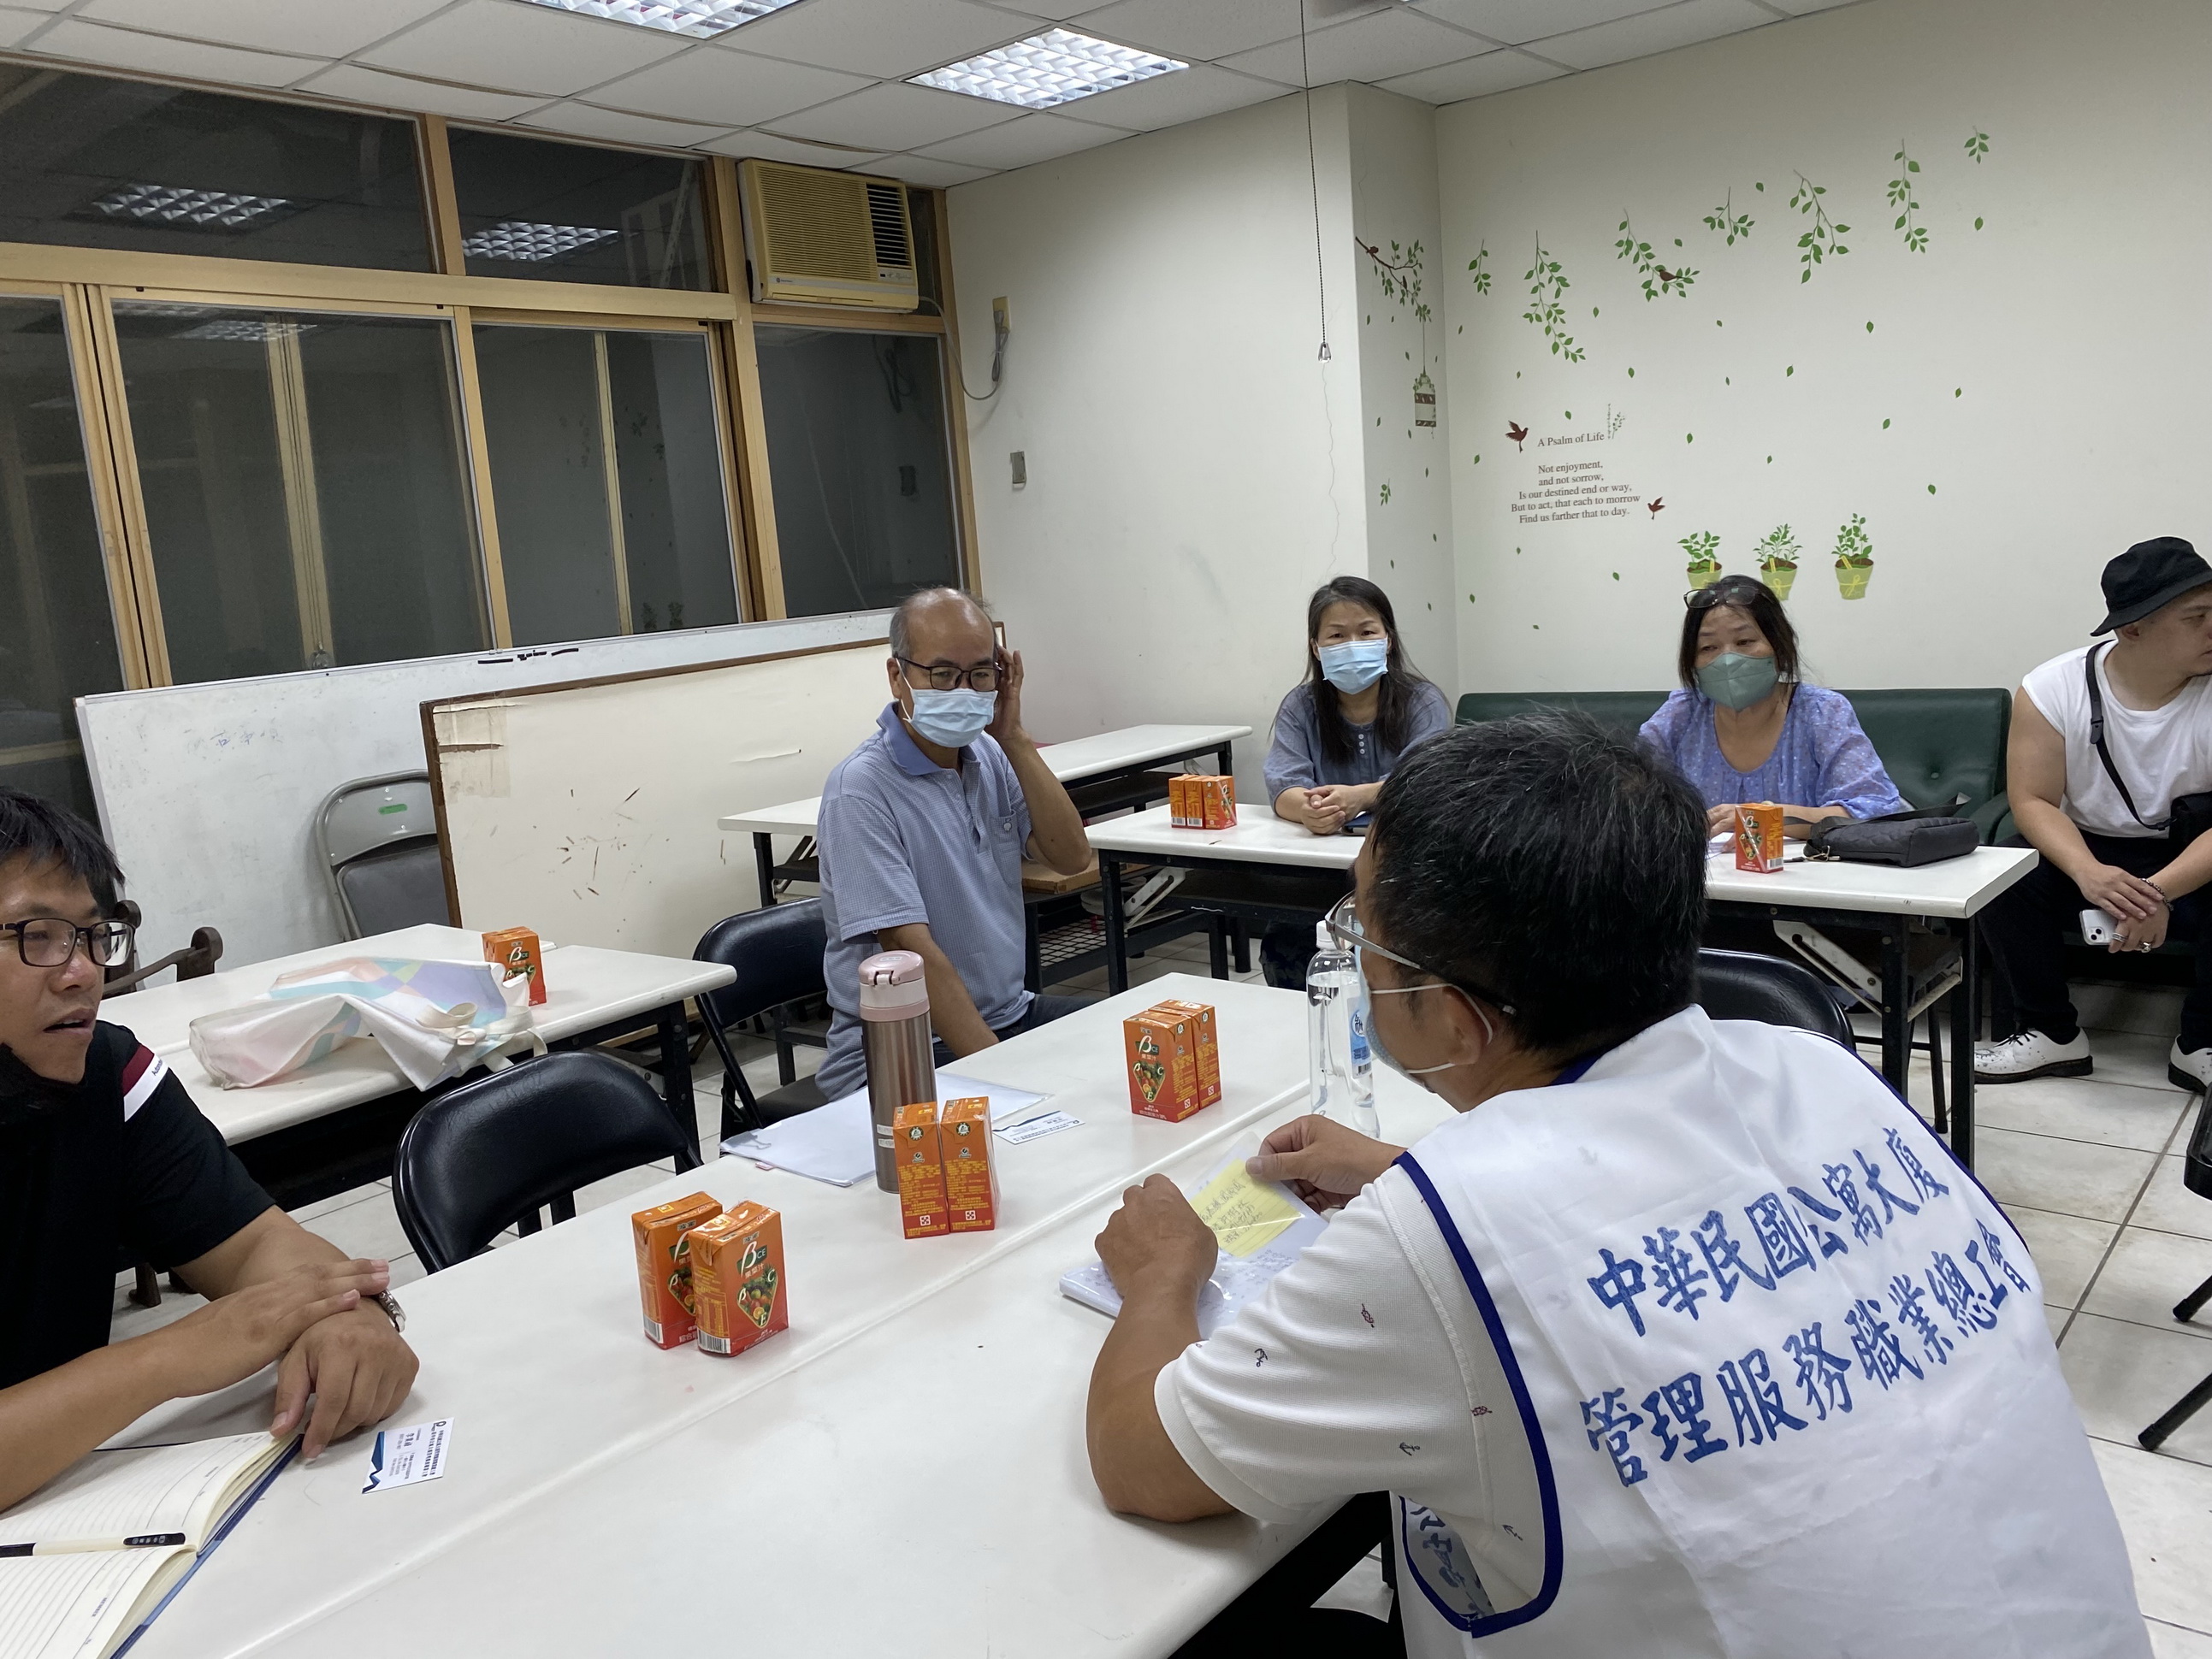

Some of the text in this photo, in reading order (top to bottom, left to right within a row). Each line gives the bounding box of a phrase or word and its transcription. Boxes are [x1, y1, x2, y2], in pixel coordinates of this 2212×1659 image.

[1537, 432, 1605, 447] A Psalm of Life
[1538, 460, 1603, 474] Not enjoyment,
[1539, 474, 1604, 486] and not sorrow,
[1545, 487, 1579, 497] destined
[1582, 485, 1597, 493] end
[1511, 503, 1525, 512] But
[1538, 501, 1553, 510] act,
[1555, 499, 1570, 507] that
[1573, 496, 1593, 505] each
[1606, 494, 1641, 504] morrow
[1519, 514, 1537, 523] Find
[1552, 511, 1579, 521] farther
[1582, 509, 1598, 518] that
[1600, 508, 1609, 517] to
[1612, 506, 1629, 517] day.
[1579, 1219, 2031, 1487] 管理服務職業總工會
